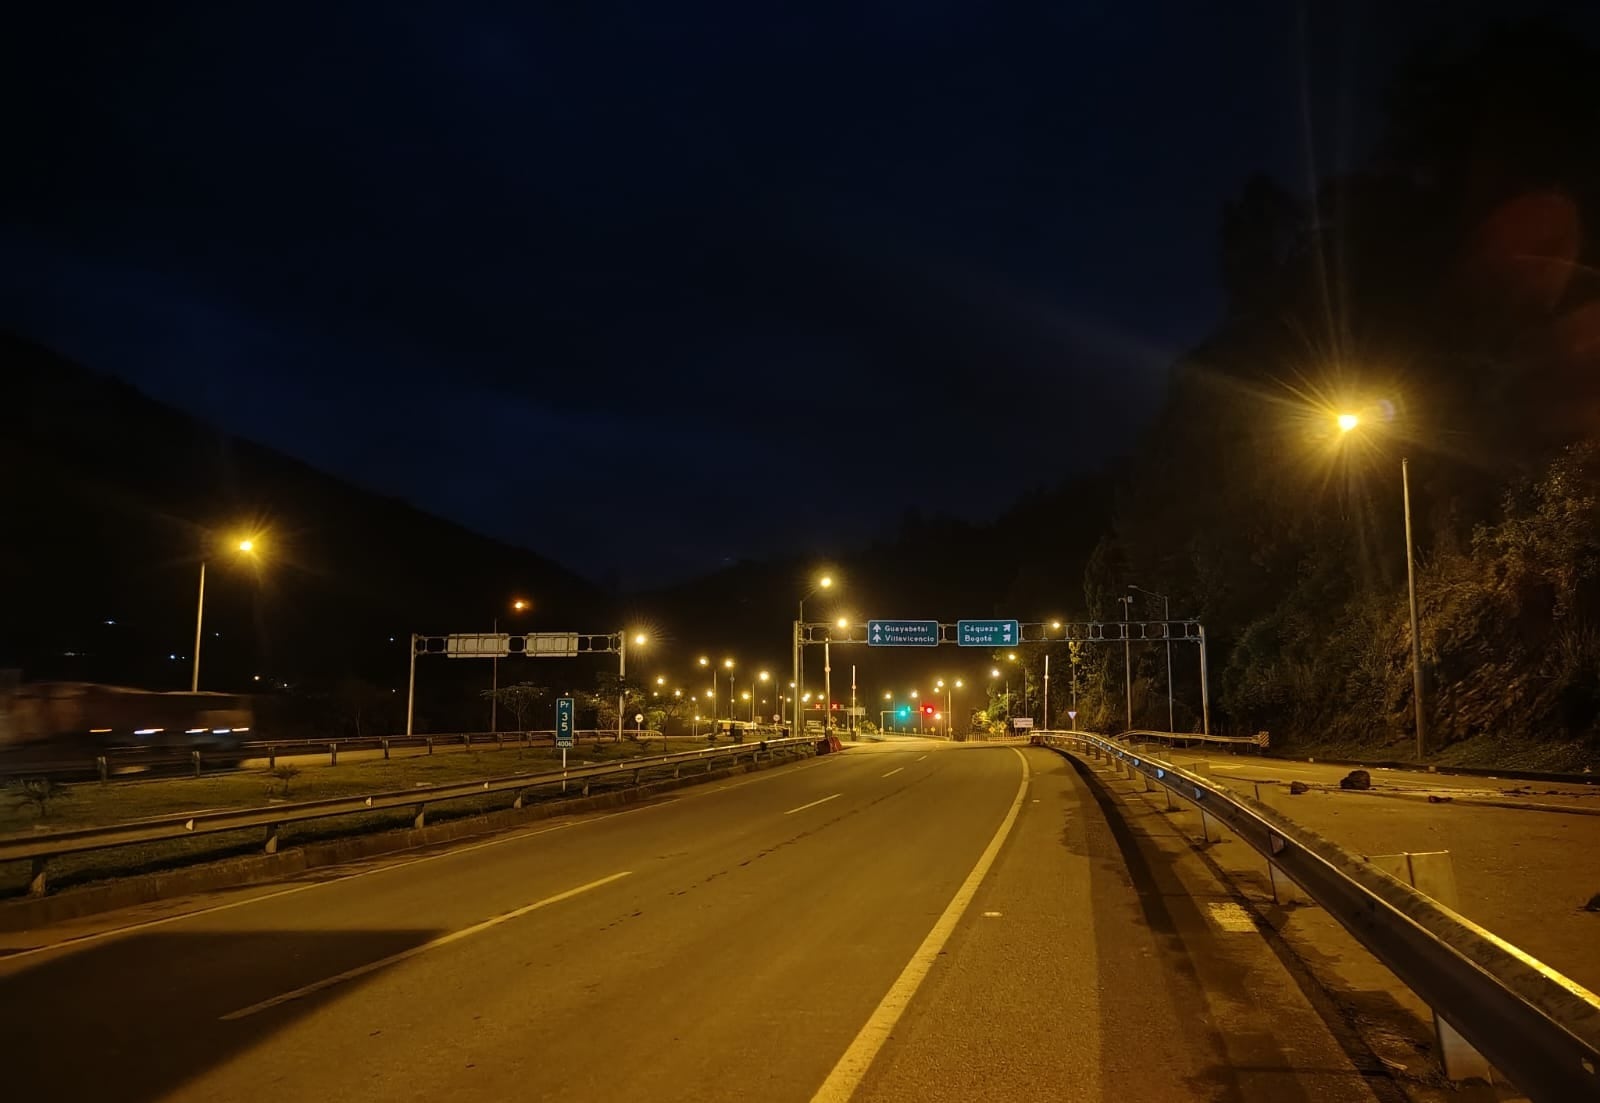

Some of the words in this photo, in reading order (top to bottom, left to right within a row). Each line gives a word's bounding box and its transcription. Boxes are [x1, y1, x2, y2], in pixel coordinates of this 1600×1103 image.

[884, 625, 928, 633] Guayabetal
[964, 624, 998, 633] Cáqueza
[885, 634, 935, 642] Villavicencio
[964, 634, 992, 642] Bogotá
